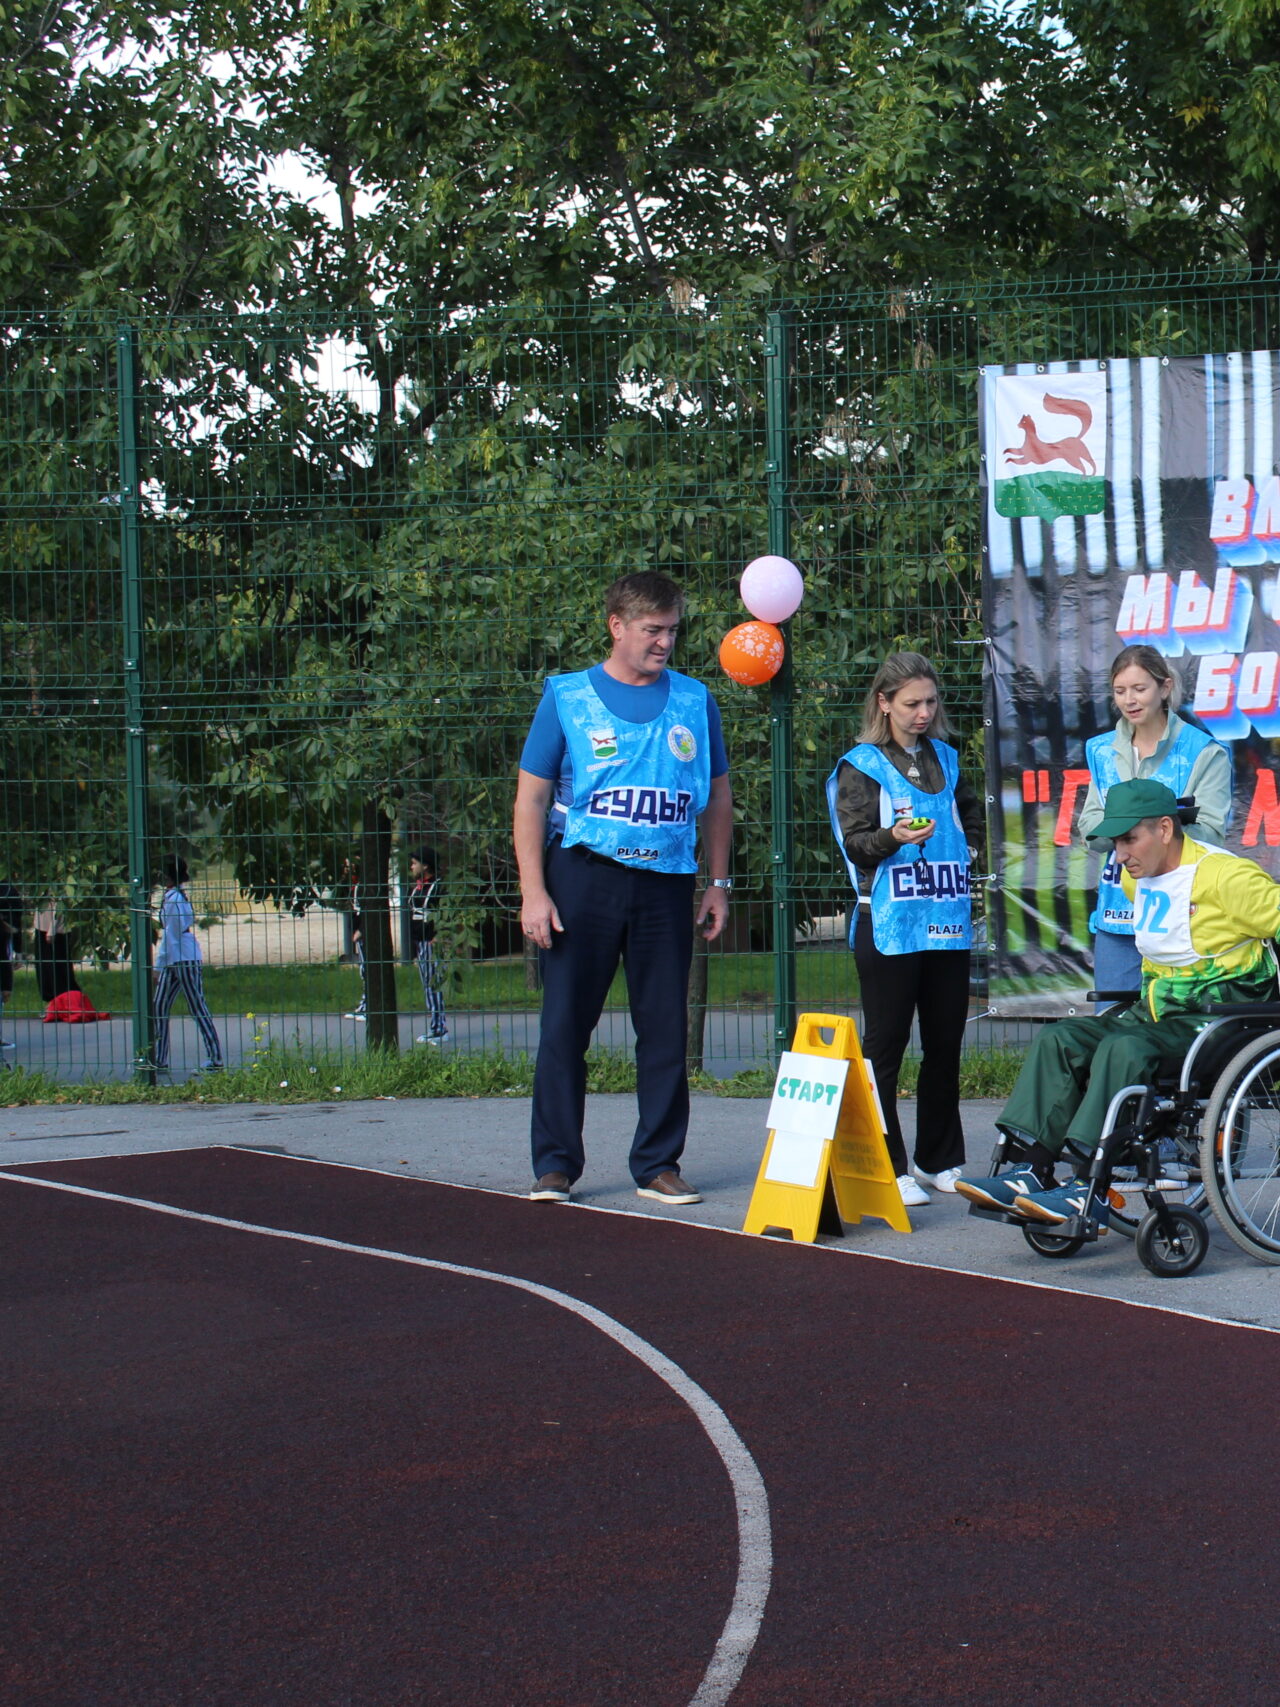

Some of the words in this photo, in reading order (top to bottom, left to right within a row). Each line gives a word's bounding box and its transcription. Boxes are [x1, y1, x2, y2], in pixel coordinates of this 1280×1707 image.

[1115, 566, 1244, 646] МЫ
[590, 788, 691, 825] СУДЬЯ
[617, 848, 659, 857] PLAZA
[1135, 888, 1171, 934] 72
[777, 1076, 839, 1106] СТАРТ
